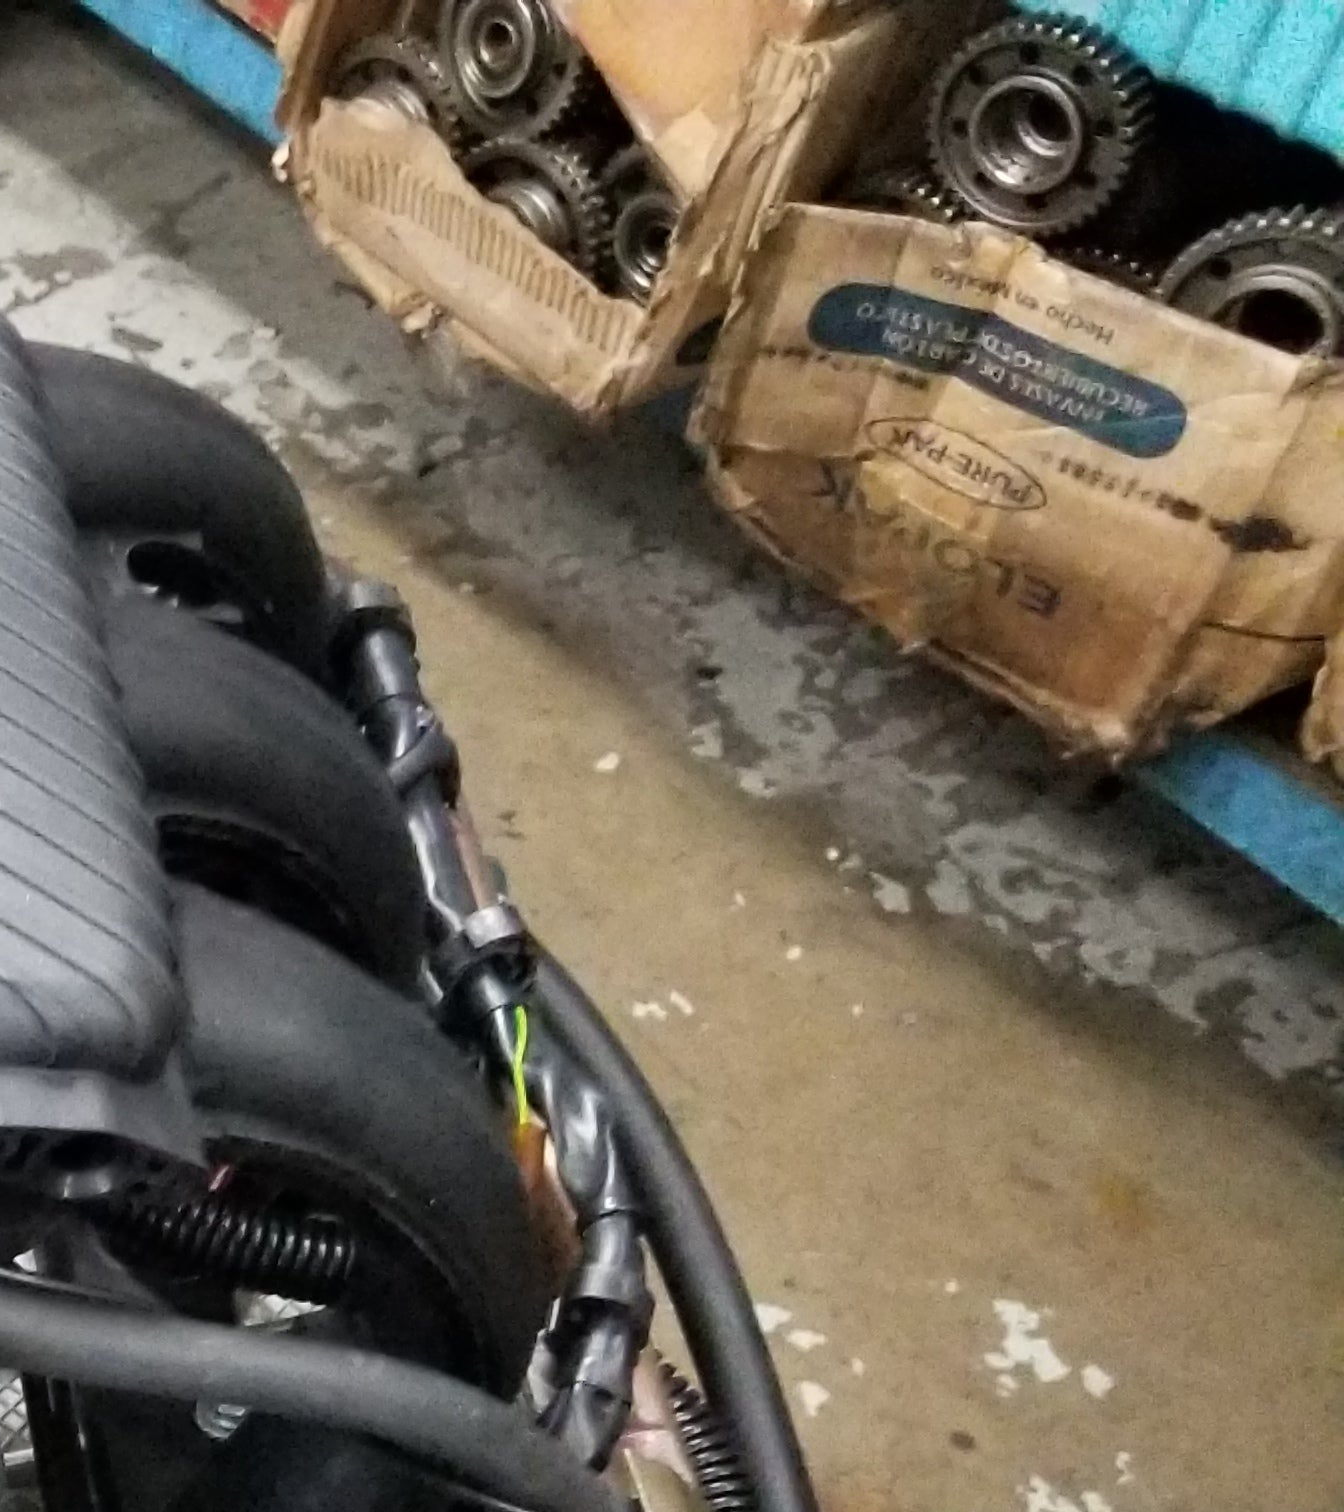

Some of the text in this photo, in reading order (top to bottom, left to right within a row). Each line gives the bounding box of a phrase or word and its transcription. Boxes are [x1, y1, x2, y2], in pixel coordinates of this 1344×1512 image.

[1014, 292, 1041, 311] en
[1045, 304, 1115, 345] Hecho
[890, 424, 1033, 502] PURE-PAK
